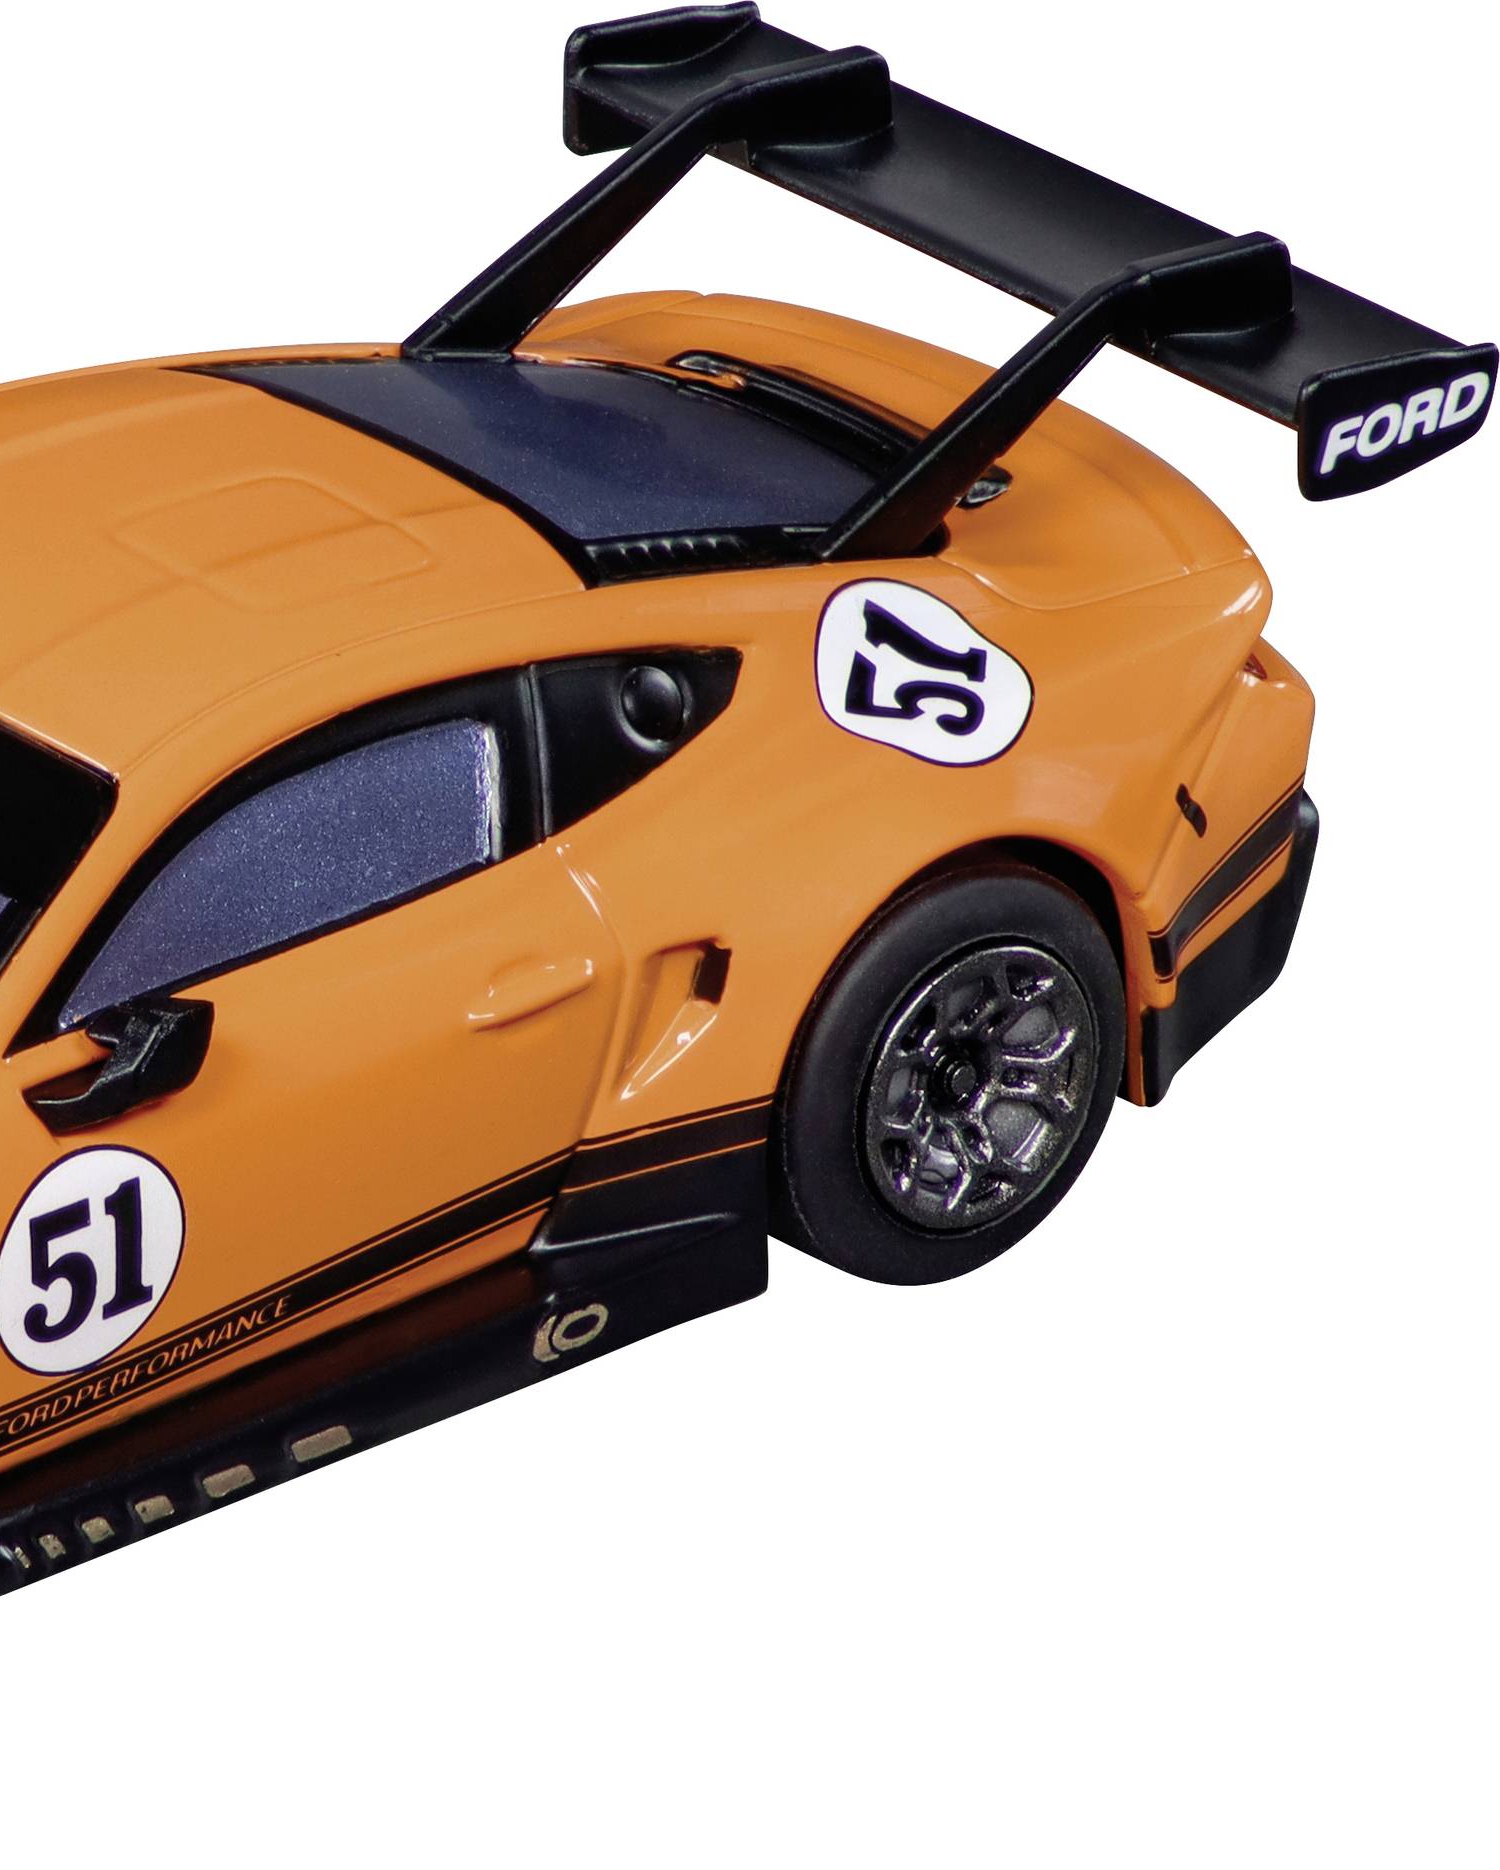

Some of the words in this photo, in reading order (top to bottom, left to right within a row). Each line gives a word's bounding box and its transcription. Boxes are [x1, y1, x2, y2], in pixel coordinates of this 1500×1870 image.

[1319, 371, 1491, 475] FORD
[845, 598, 988, 736] 51
[24, 1176, 153, 1343] 51
